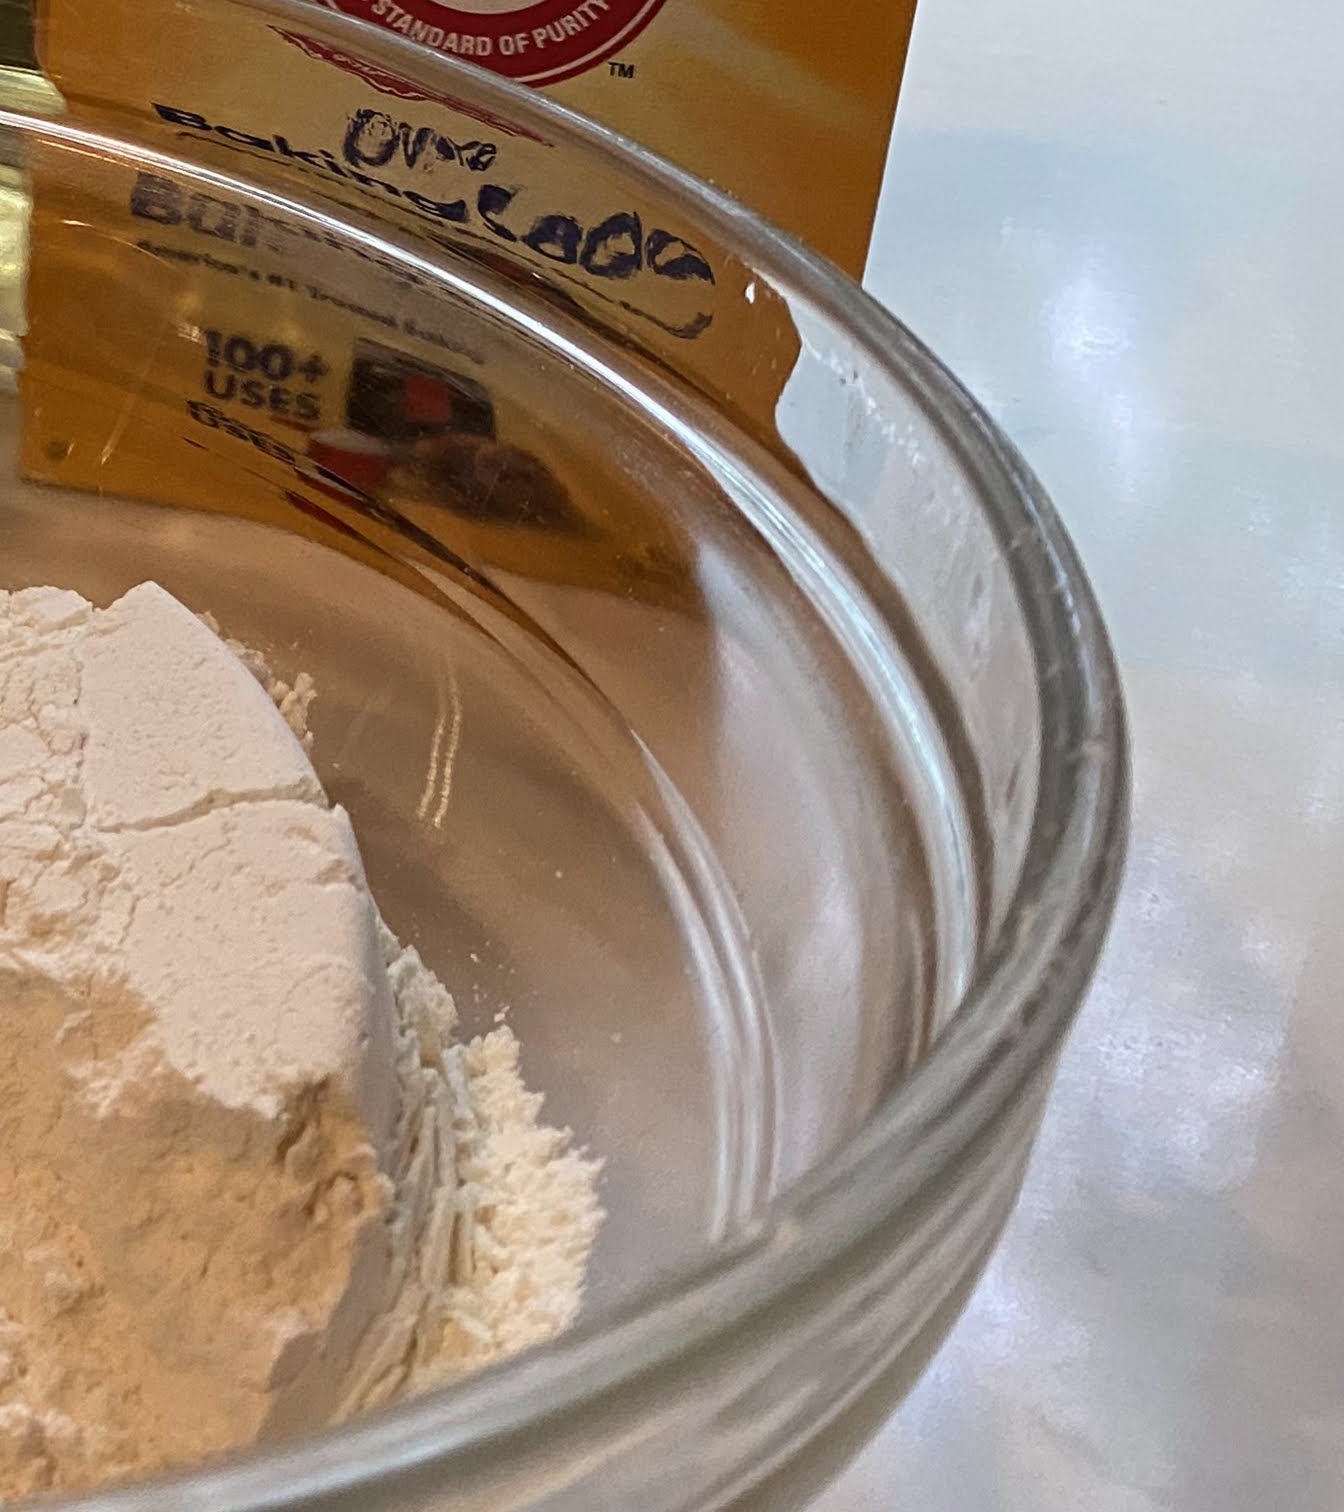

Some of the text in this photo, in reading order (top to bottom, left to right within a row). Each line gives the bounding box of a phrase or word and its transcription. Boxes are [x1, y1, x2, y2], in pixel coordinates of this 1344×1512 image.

[498, 31, 530, 57] OF
[607, 62, 636, 80] TM
[205, 328, 329, 383] 100+
[204, 370, 321, 421] USES
